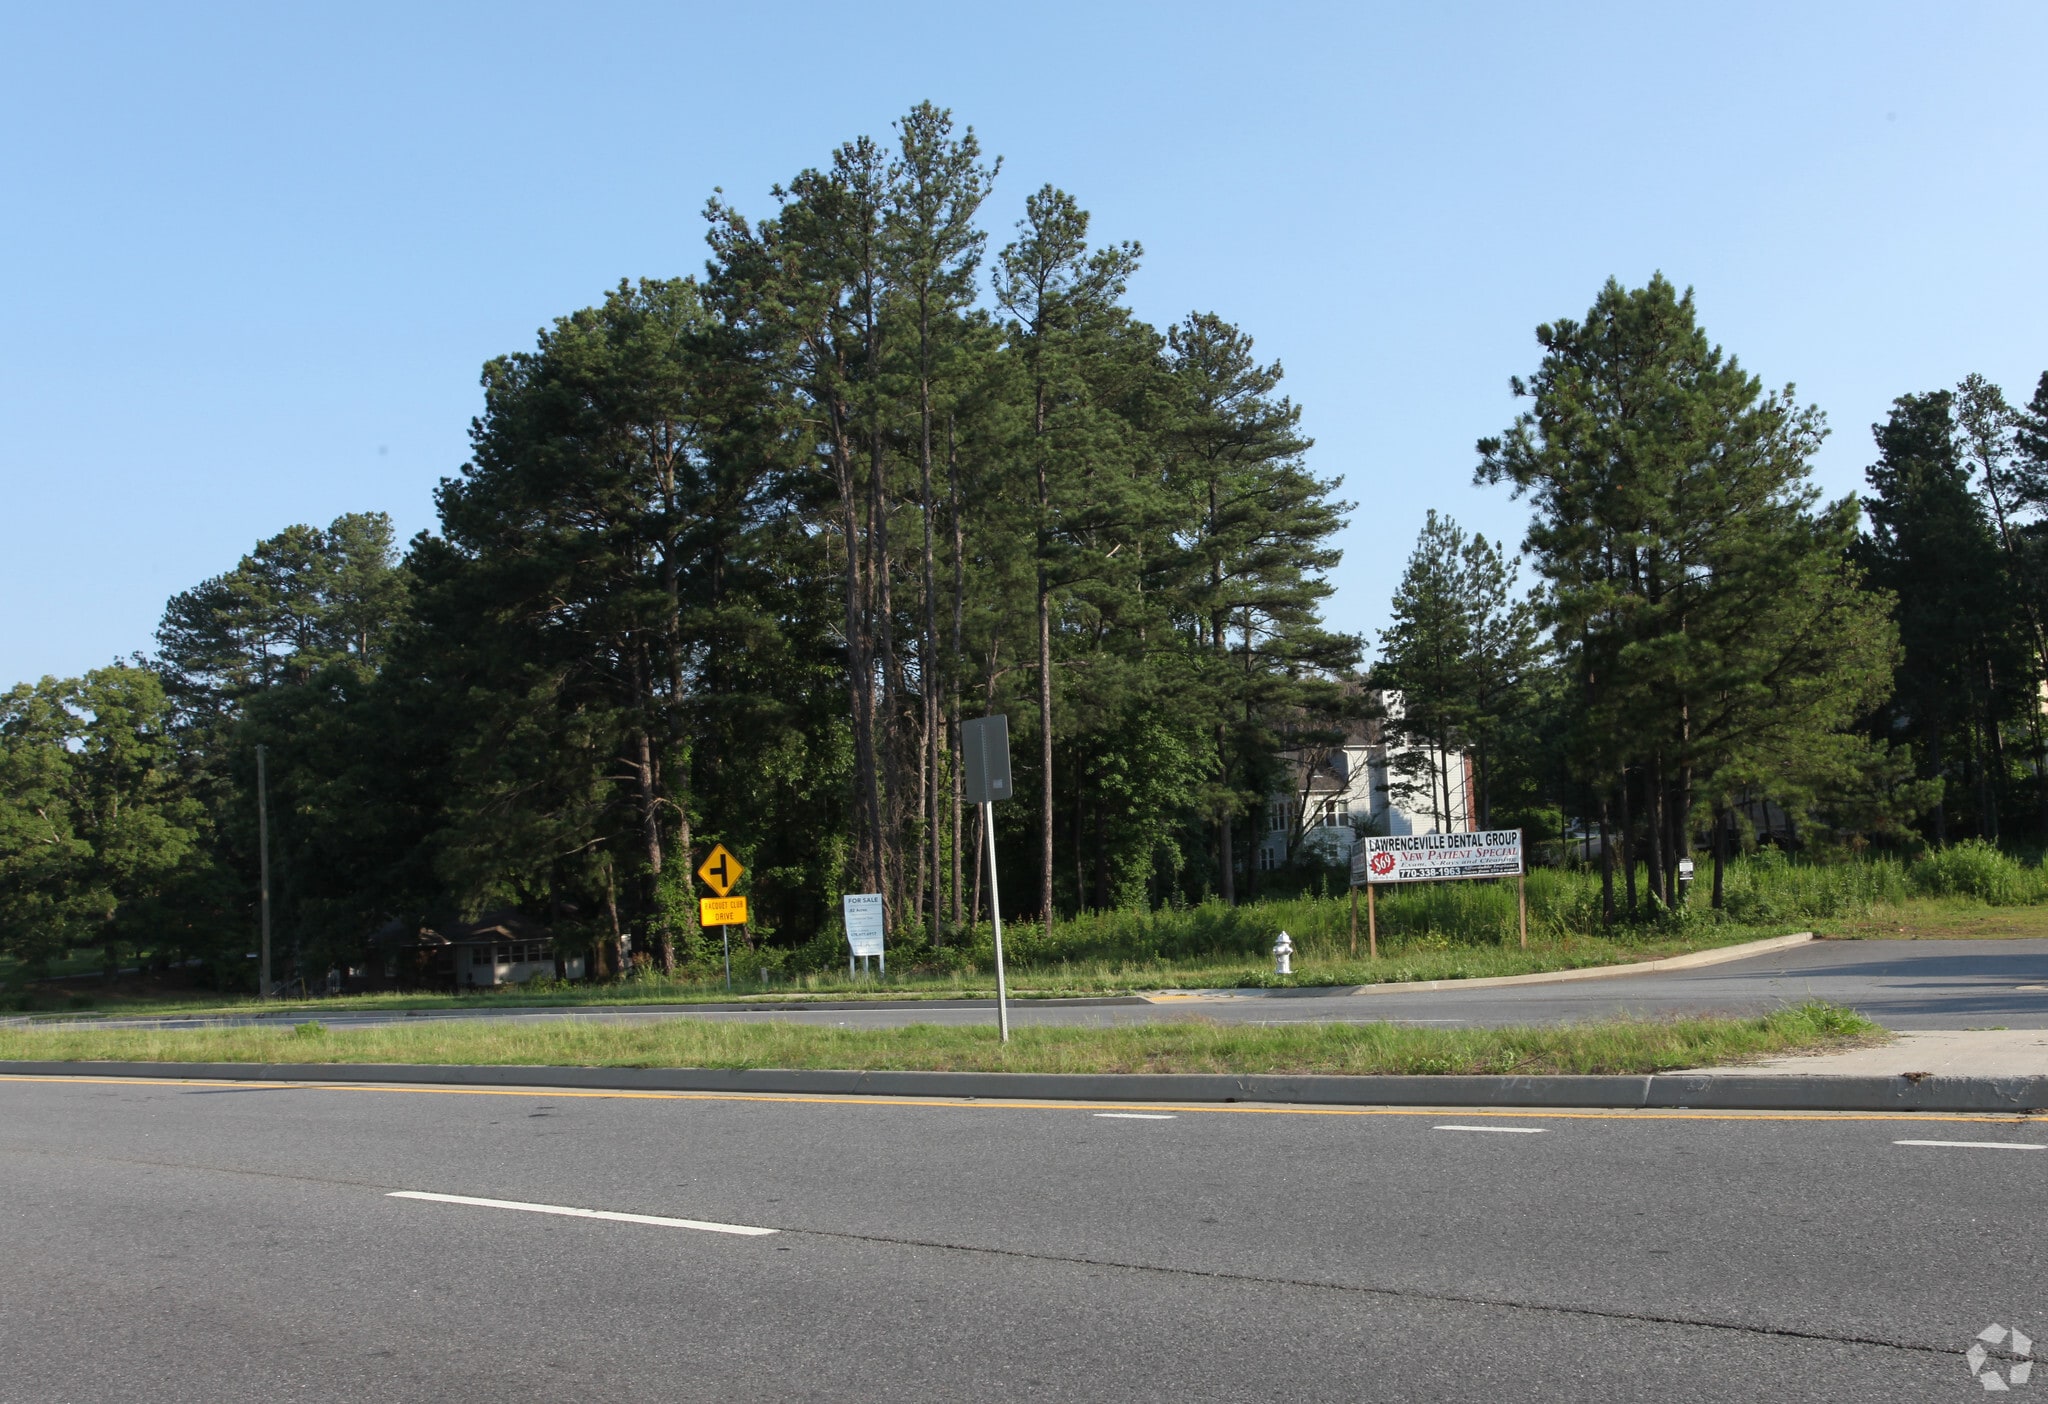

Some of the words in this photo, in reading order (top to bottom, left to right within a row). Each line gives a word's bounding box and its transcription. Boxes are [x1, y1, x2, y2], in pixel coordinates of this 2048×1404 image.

[1369, 835, 1445, 851] LAWRENCEVILLE
[1447, 833, 1483, 849] DENTAL
[1485, 832, 1517, 846] GROUP
[1400, 851, 1424, 861] NEW
[1428, 849, 1472, 860] PATIENT
[1475, 847, 1518, 858] SPECIAL
[1480, 856, 1518, 864] Cleaning
[1373, 854, 1391, 872] $69
[1400, 866, 1461, 878] 770-338-1963
[705, 901, 728, 909] RACQUET
[731, 901, 743, 909] CLUB
[715, 912, 734, 920] DRIVE
